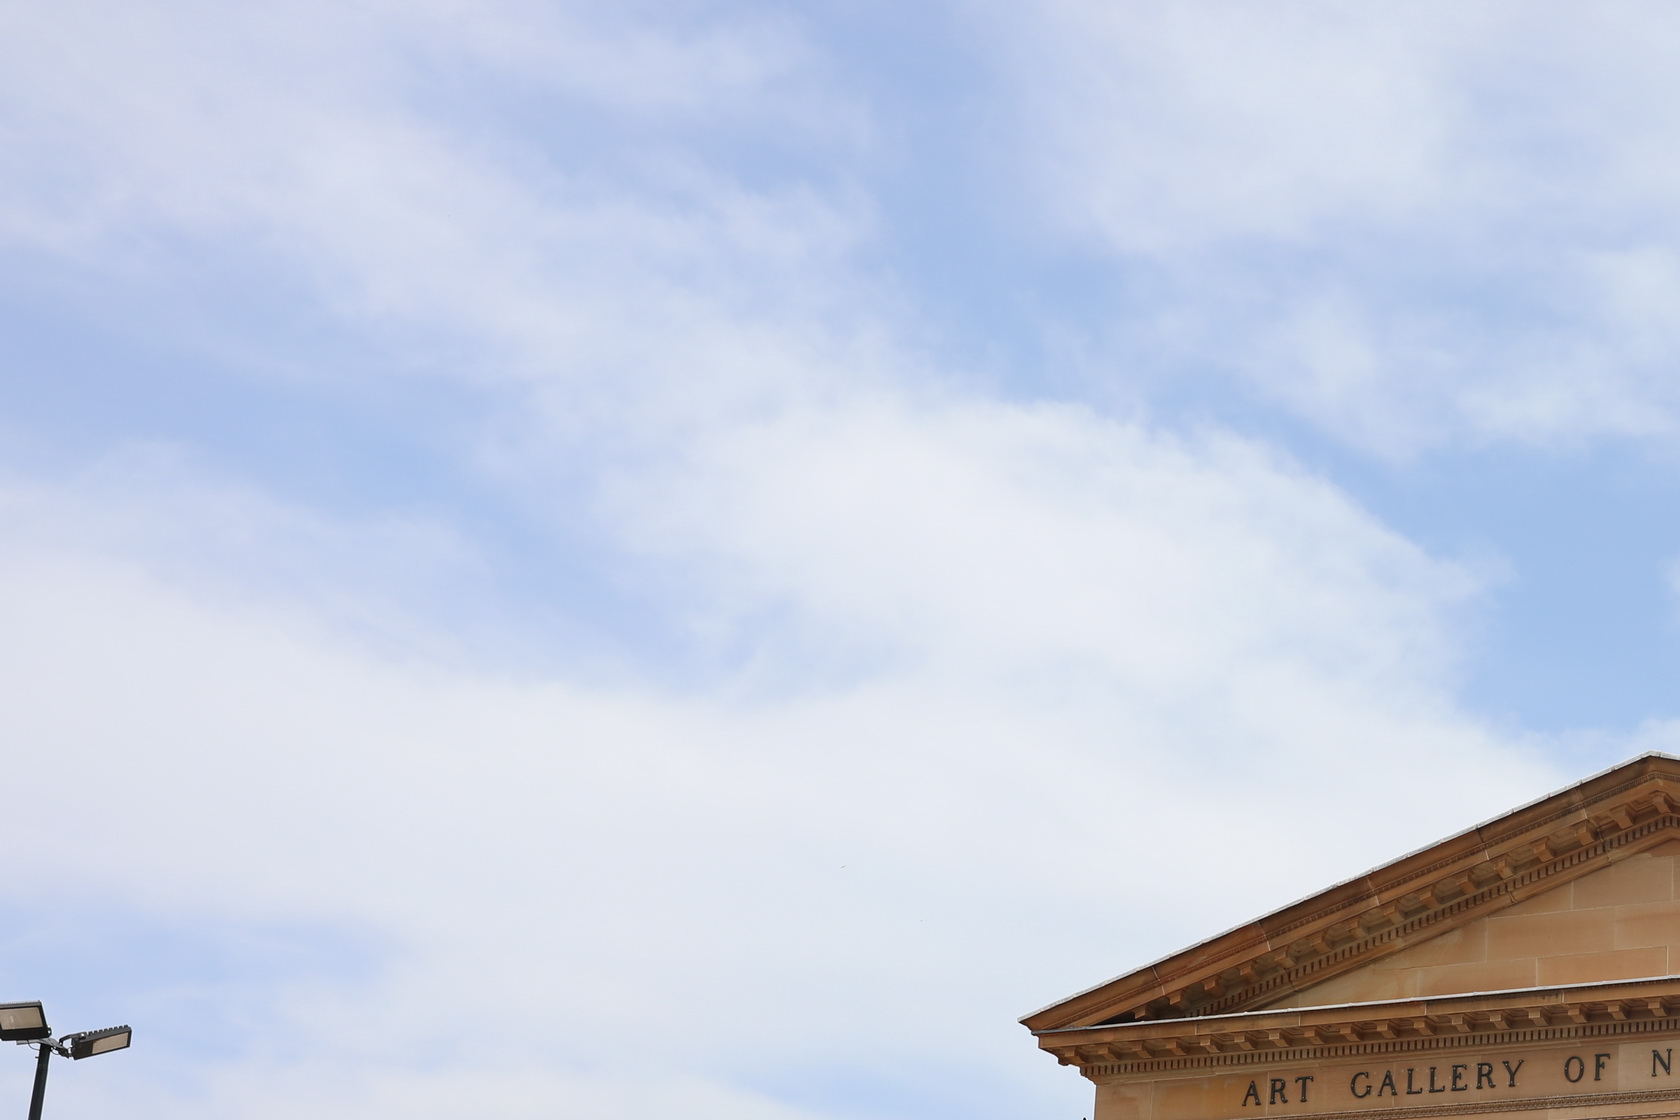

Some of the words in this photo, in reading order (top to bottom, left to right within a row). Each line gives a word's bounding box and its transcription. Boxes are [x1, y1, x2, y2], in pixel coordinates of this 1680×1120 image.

[1242, 1075, 1314, 1106] ART
[1350, 1059, 1524, 1099] GALLERY
[1563, 1052, 1611, 1083] OF
